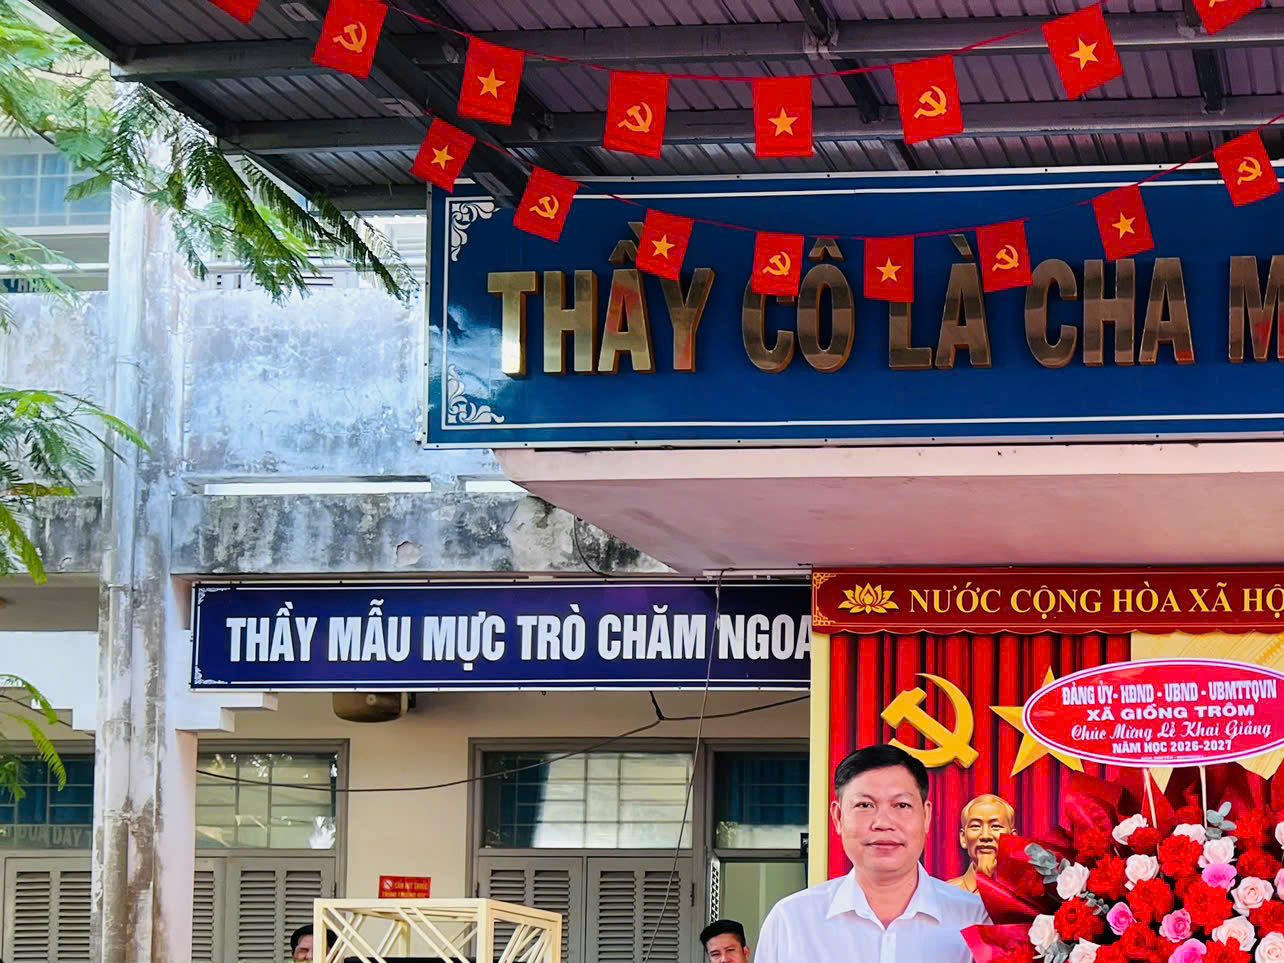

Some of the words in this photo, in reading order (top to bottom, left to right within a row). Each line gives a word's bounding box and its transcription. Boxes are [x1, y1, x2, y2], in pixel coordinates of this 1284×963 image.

[488, 222, 715, 374] THẦY
[741, 237, 855, 373] CÔ
[888, 235, 991, 370] LÀ
[1025, 257, 1195, 367] CHA
[909, 582, 1001, 614] NƯỚC
[1010, 585, 1102, 619] CỘNG
[1112, 581, 1179, 613] HÒA
[1189, 582, 1231, 613] XÃ
[226, 601, 316, 663] THẦY
[328, 598, 409, 663] MẪU
[422, 609, 505, 671] MỰC
[517, 604, 589, 662] TRÒ
[598, 605, 706, 661] CHĂM
[1062, 682, 1095, 705] ĐẢNG
[1120, 684, 1154, 704] HĐND
[1164, 682, 1198, 702] UBND
[1208, 680, 1277, 702] UBMTTQVN
[1087, 707, 1115, 721] XÃ
[1120, 703, 1188, 720] GIỒNG
[1194, 702, 1255, 718] TRÔM
[1071, 724, 1107, 741] Chúc
[1110, 723, 1153, 741] Mừng
[1180, 720, 1220, 737] Khai
[1225, 720, 1272, 739] Giảng
[1112, 741, 1141, 754] NĂM
[1144, 741, 1167, 755] HỌC
[1170, 740, 1233, 752] 2026-2027
